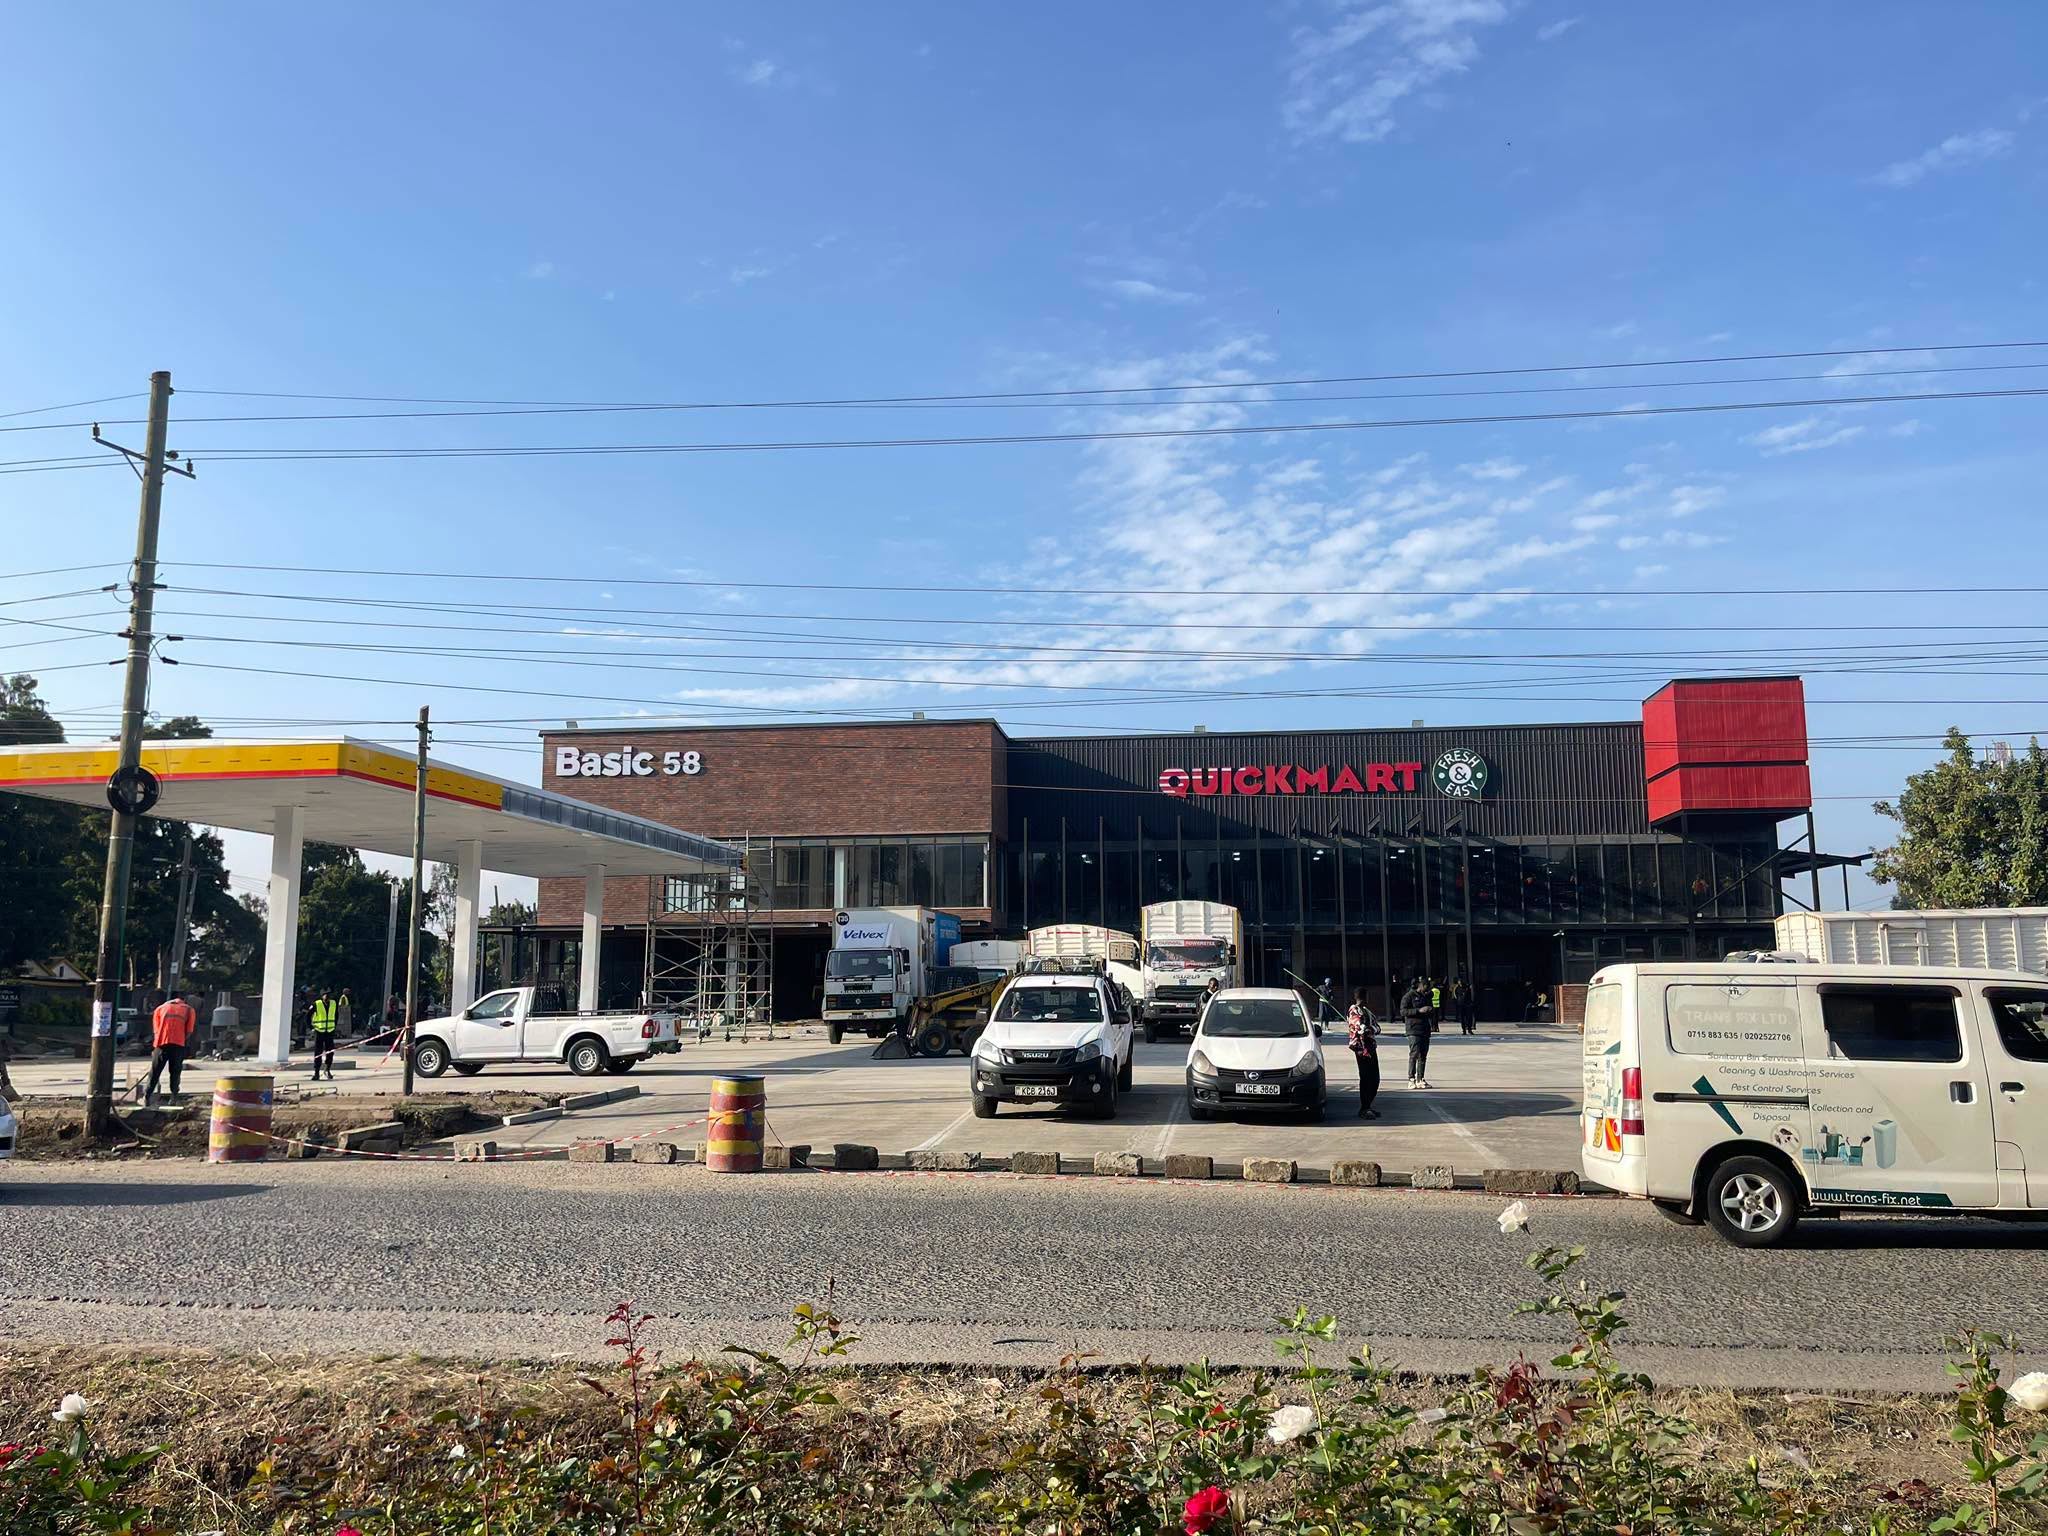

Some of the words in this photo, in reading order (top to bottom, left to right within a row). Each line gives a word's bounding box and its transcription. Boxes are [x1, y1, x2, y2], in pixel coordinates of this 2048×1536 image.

[555, 746, 654, 776] Basic
[662, 751, 701, 775] 58
[1438, 750, 1480, 770] FRESH
[1159, 761, 1422, 798] QUICKMART
[1454, 766, 1467, 781] &
[1445, 780, 1478, 797] EASY
[843, 930, 885, 940] Velvex
[1687, 1030, 1706, 1039] 0715
[1708, 1031, 1722, 1039] 883
[1724, 1031, 1739, 1040] 635
[1744, 1032, 1792, 1042] 0202522706
[1762, 1054, 1799, 1063] Services
[1718, 1066, 1756, 1077] Cleaning
[1758, 1067, 1766, 1076] &
[1769, 1067, 1817, 1078] Washroom
[1819, 1069, 1856, 1079] Services
[1021, 1086, 1037, 1096] KCB
[1243, 1084, 1258, 1093] KCE
[1731, 1083, 1749, 1092] Pest
[1752, 1083, 1783, 1093] Control
[1786, 1085, 1821, 1095] Services
[1812, 1103, 1853, 1113] Collection
[1856, 1105, 1874, 1114] and
[1753, 1112, 1791, 1122] Disposal
[1811, 1191, 1921, 1206] www.trans-fix.net
